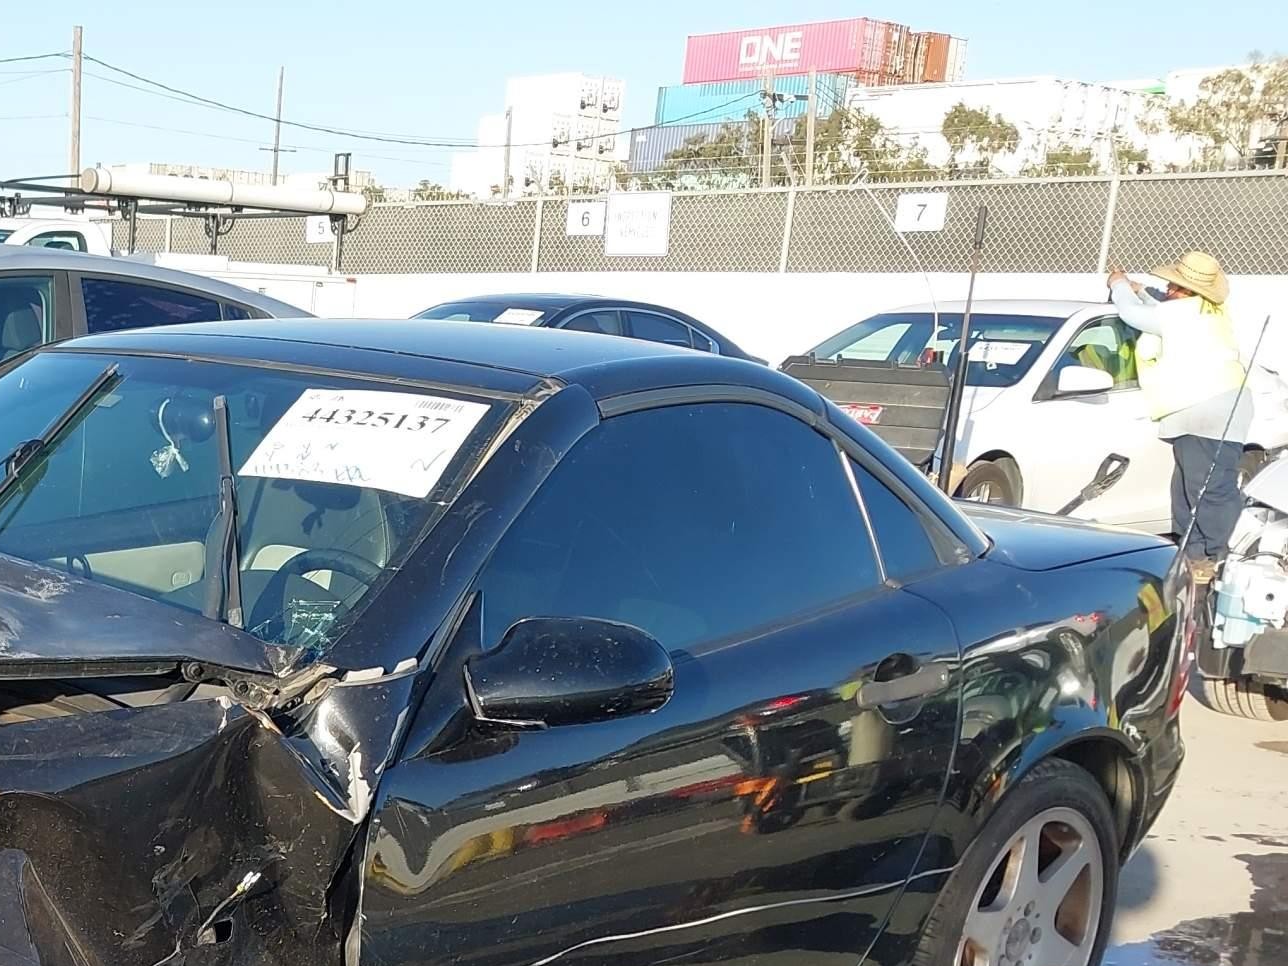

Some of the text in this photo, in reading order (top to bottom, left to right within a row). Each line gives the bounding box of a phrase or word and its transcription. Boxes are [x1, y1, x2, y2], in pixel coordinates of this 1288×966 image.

[739, 31, 803, 65] ONE
[581, 211, 591, 227] 6
[916, 203, 928, 222] 7
[318, 221, 326, 235] 5
[302, 407, 451, 434] 44325137
